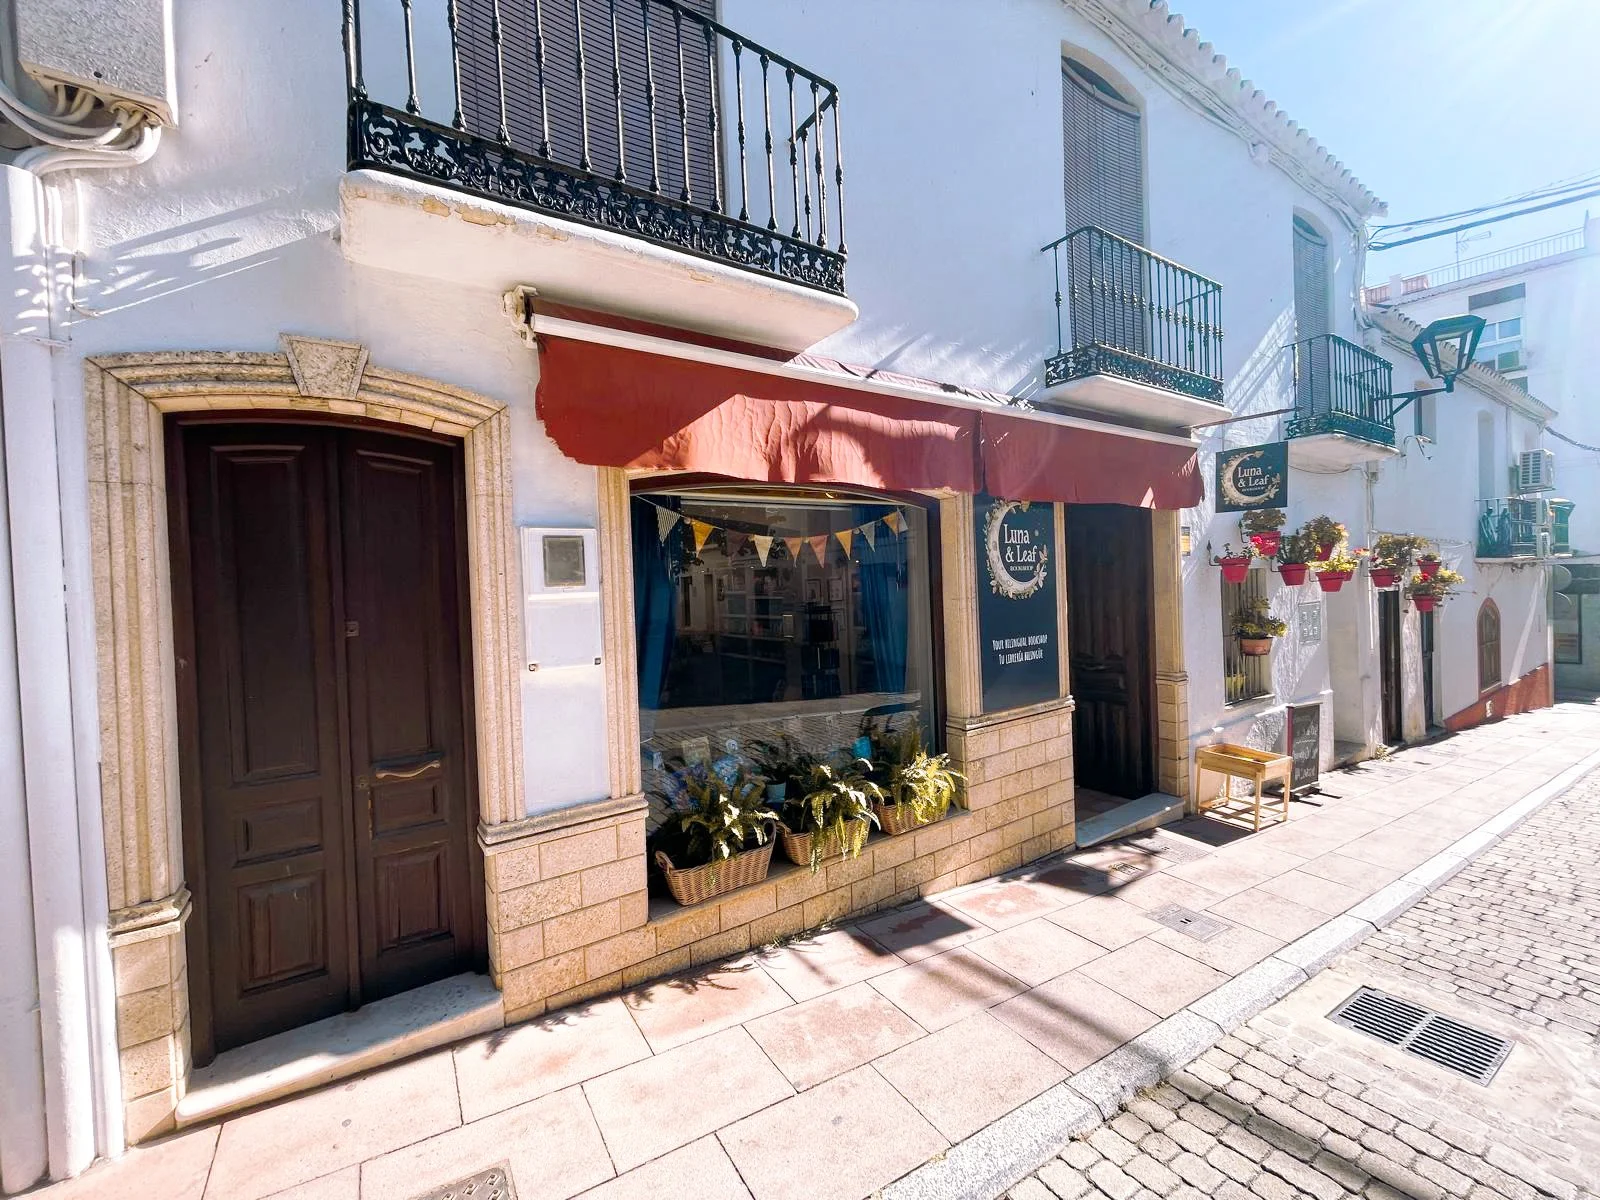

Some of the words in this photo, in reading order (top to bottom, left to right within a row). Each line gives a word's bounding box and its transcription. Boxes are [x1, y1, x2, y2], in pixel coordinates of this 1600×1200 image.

[1238, 467, 1262, 478] Luna
[1238, 478, 1246, 488] &
[1249, 474, 1270, 487] Leaf
[1003, 523, 1030, 544] Luna
[1005, 546, 1014, 563] &
[1016, 545, 1038, 562] Leaf
